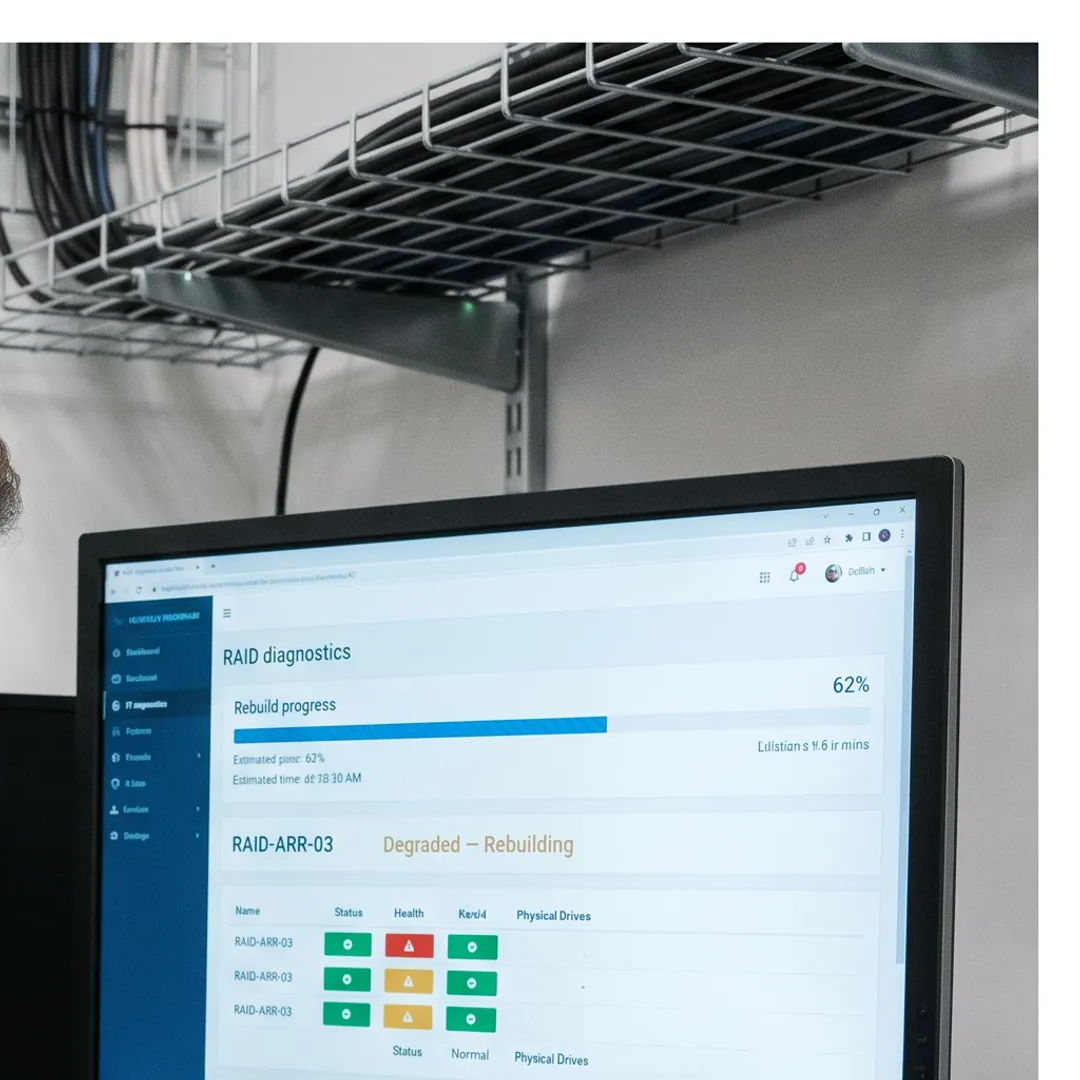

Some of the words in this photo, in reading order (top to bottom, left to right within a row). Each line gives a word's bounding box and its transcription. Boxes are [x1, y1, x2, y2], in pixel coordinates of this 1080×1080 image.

[223, 648, 259, 665] RAID
[263, 643, 351, 667] diagnostics
[833, 675, 870, 693] 62%
[234, 699, 279, 715] Rebuild
[282, 700, 336, 716] progress
[305, 753, 325, 763] 62%
[233, 774, 277, 785] Estimated
[345, 772, 362, 783] AM
[232, 836, 334, 853] RAID-ARR-03
[383, 834, 461, 856] Degraded
[484, 834, 574, 858] Rebuilding
[235, 906, 261, 916] Name
[334, 907, 363, 918] Status
[394, 908, 424, 919] Health
[516, 909, 558, 923] Physical
[559, 910, 591, 921] Drives
[235, 936, 293, 949] RAID-ARR-03
[234, 970, 293, 983] RAID-ARR-03
[234, 1004, 292, 1017] RAID-ARR-03
[392, 1045, 422, 1058] Status
[451, 1049, 489, 1061] Normal
[514, 1051, 555, 1066] Physical
[557, 1053, 589, 1067] Drives
